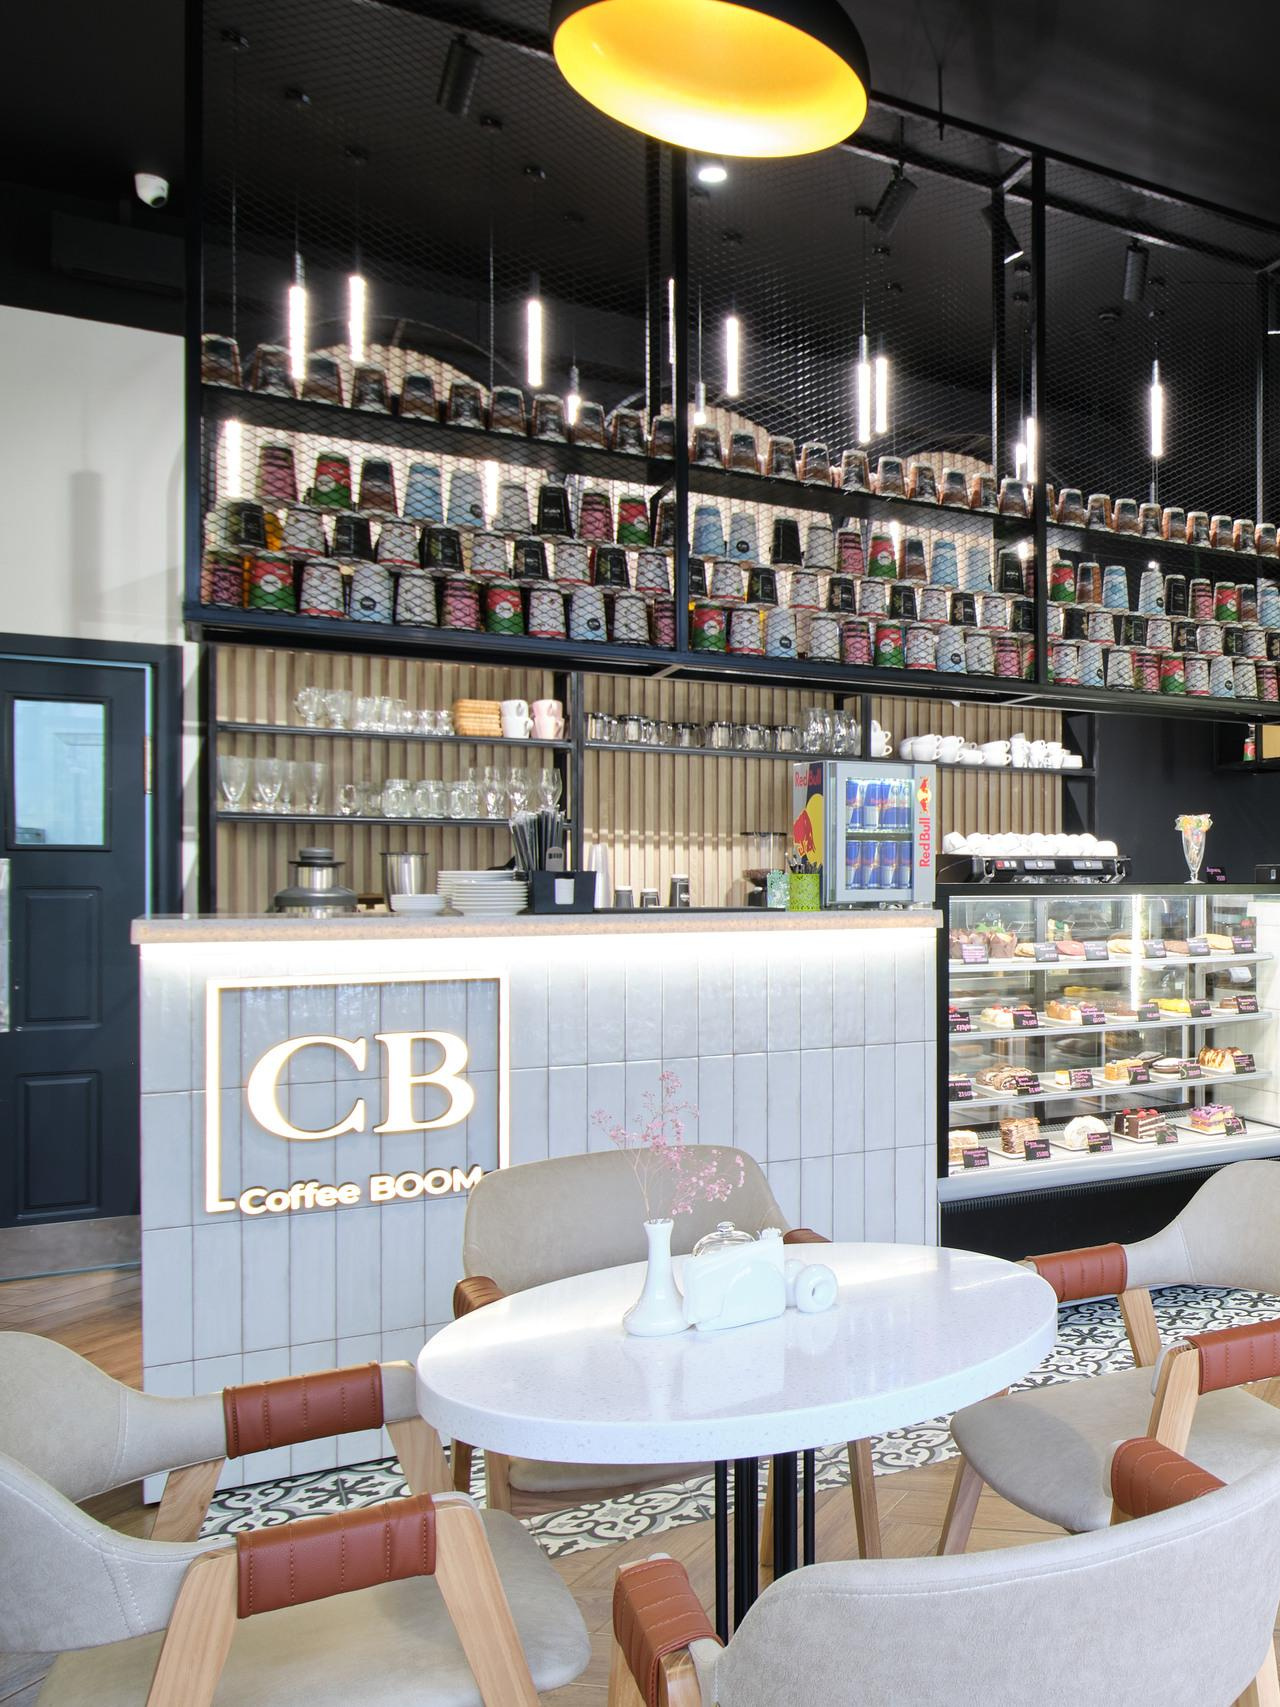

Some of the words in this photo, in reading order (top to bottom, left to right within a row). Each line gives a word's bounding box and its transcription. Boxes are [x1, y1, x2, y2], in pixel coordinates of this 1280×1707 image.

[795, 770, 808, 787] Red
[808, 766, 822, 786] Bull
[918, 817, 930, 841] Bull
[918, 843, 930, 867] Red
[247, 1030, 475, 1140] CB
[239, 1178, 361, 1216] Coffee
[369, 1164, 483, 1203] BOOM
